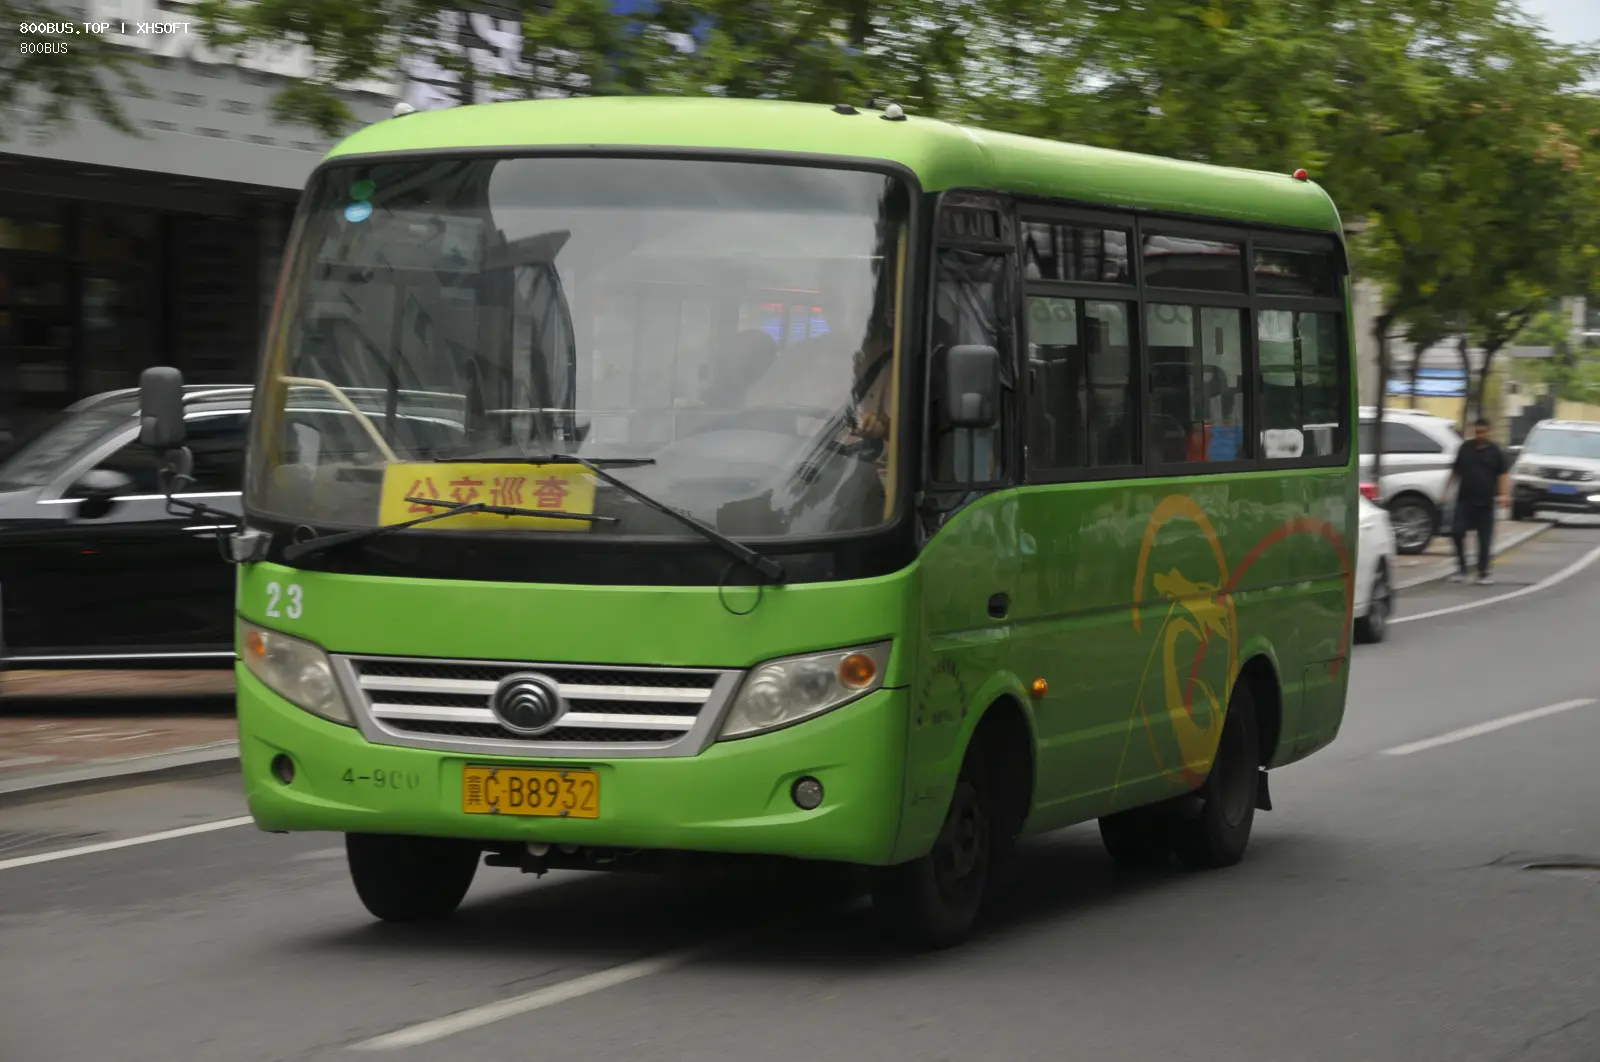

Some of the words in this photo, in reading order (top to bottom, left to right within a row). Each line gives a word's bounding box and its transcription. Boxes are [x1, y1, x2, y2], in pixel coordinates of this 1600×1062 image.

[406, 475, 571, 515] 公交巡查
[265, 581, 304, 619] 23
